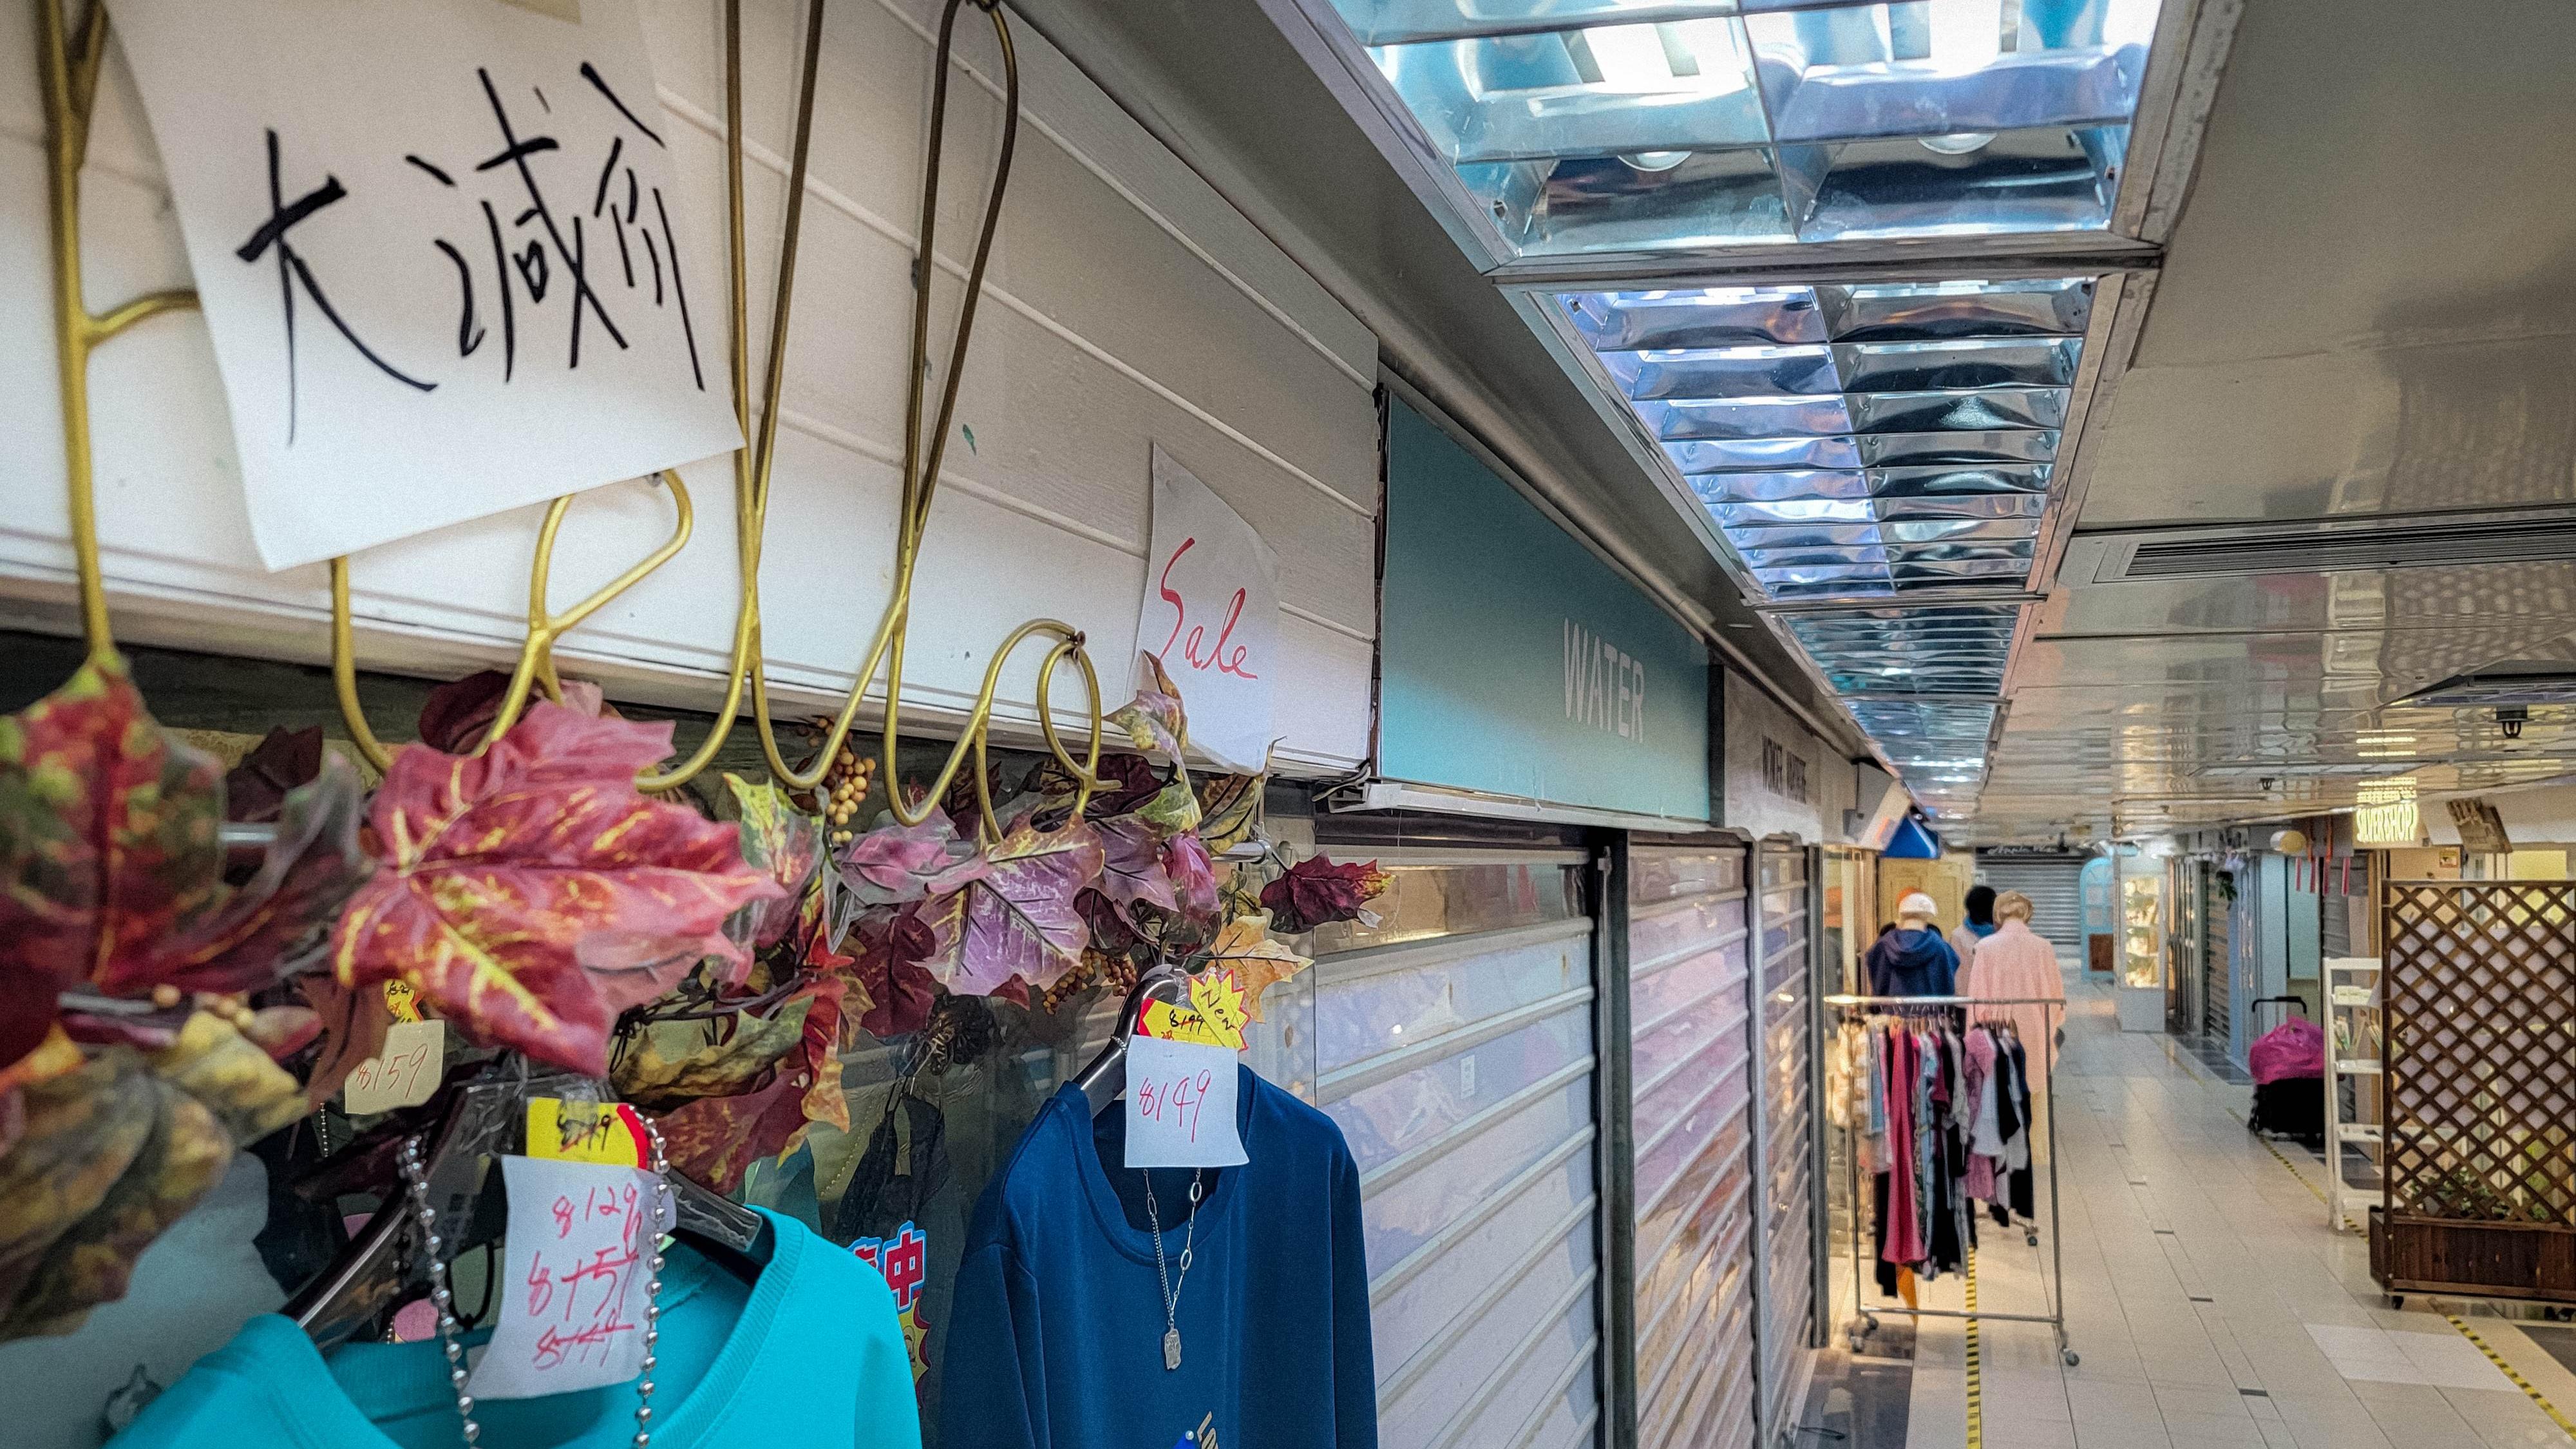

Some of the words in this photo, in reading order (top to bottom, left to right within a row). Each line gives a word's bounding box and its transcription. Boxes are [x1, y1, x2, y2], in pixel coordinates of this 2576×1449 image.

[1160, 537, 1258, 679] Sale
[1564, 616, 1645, 743] WATER
[356, 1043, 428, 1099] $159
[1139, 1068, 1211, 1144] $149
[552, 1182, 638, 1243] $129
